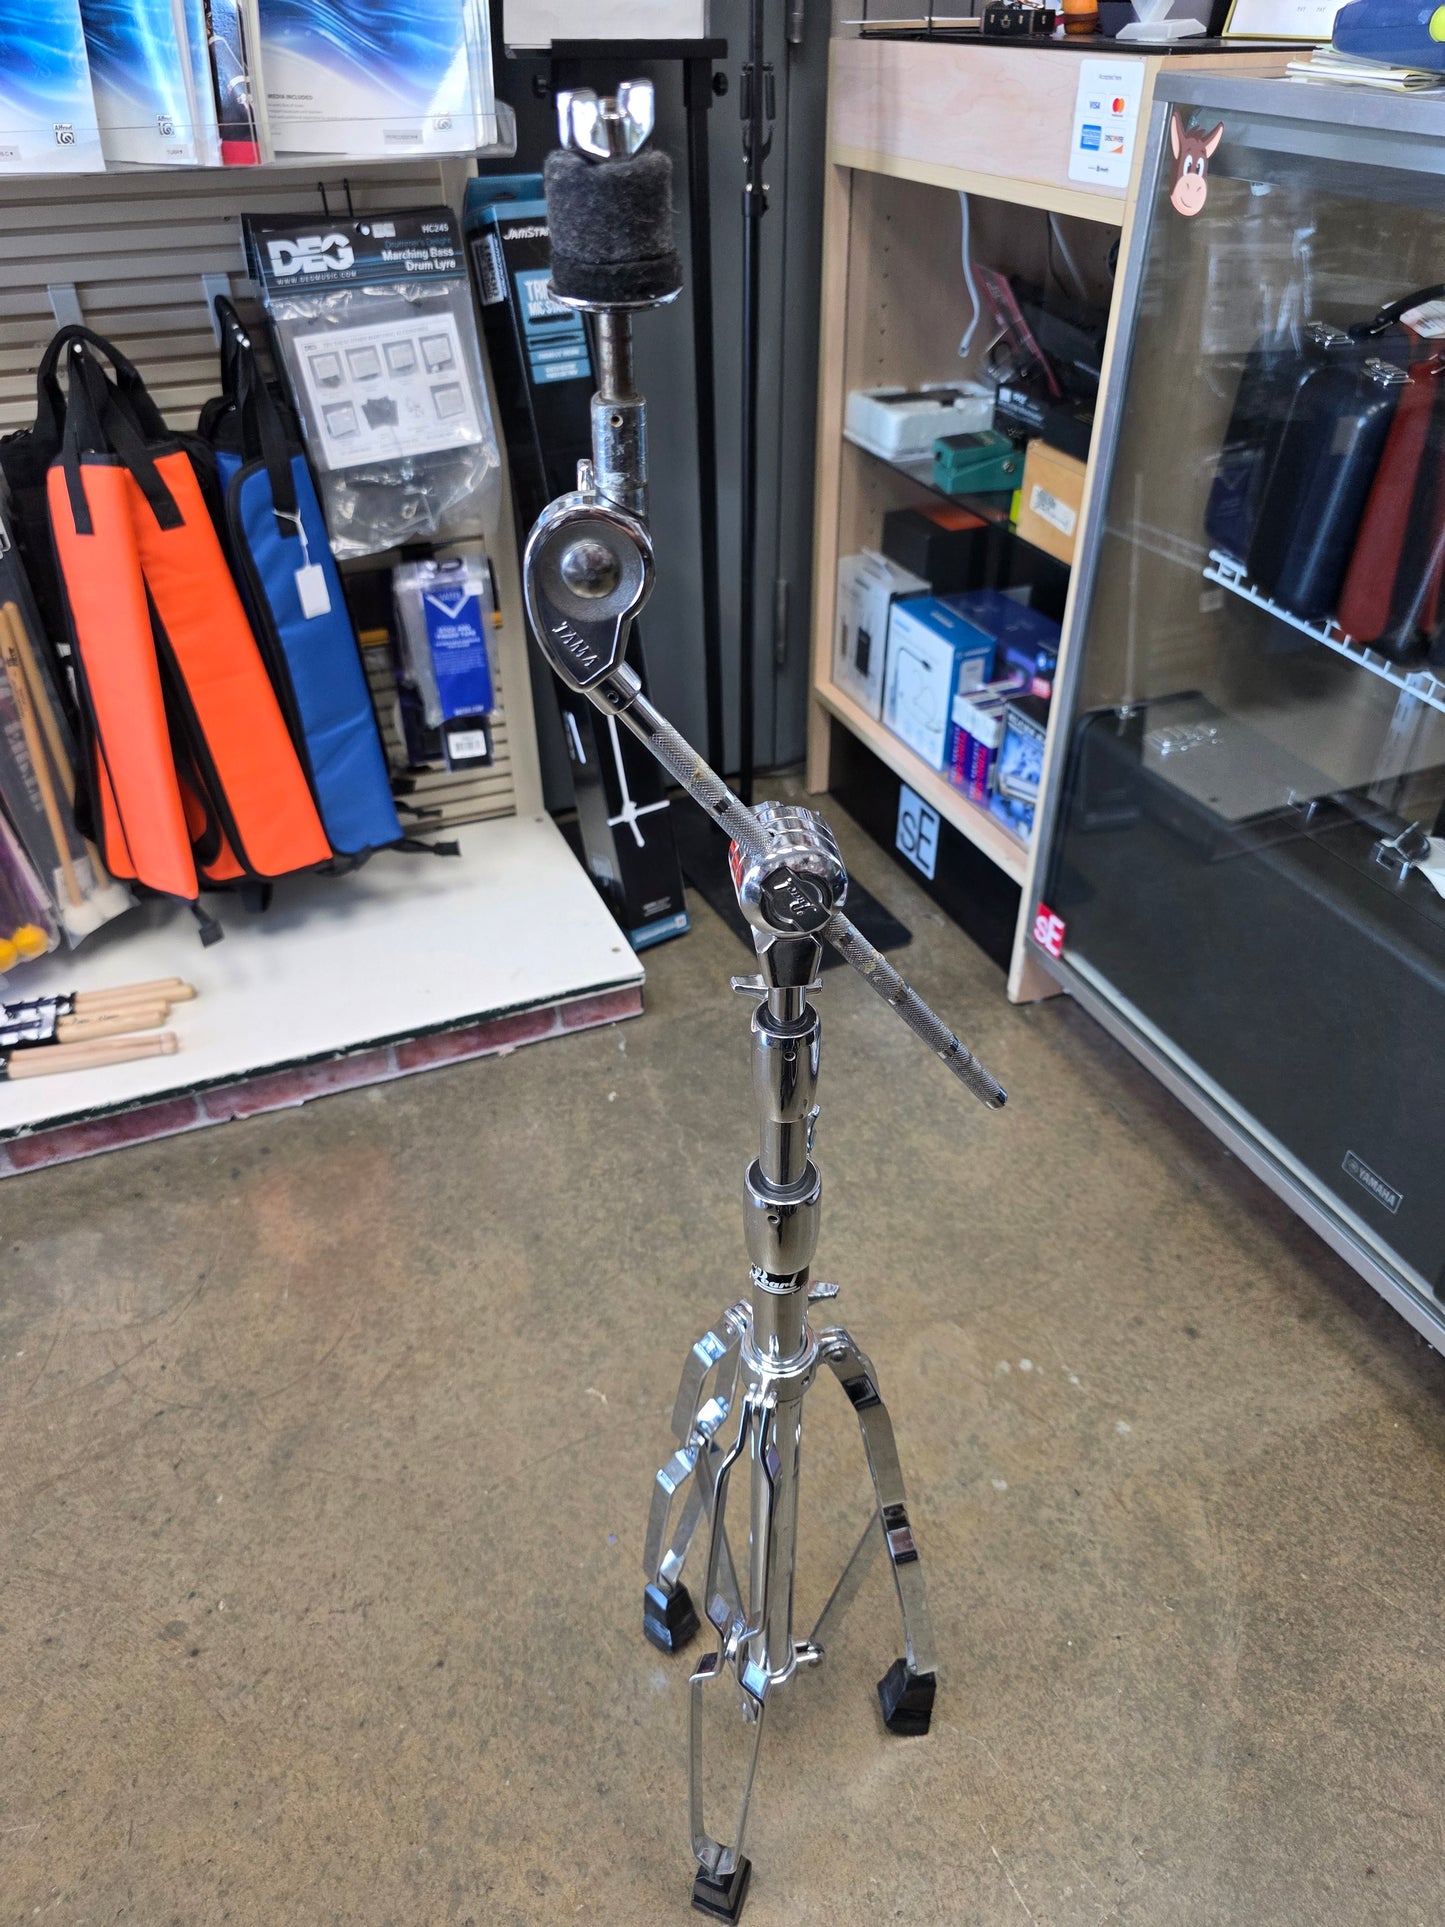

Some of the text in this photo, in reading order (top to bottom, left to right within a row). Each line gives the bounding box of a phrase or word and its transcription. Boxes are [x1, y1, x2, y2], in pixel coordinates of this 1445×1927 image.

[1089, 101, 1101, 109] VISA
[267, 235, 355, 277] DEG
[381, 246, 454, 262] Marching Bass
[405, 258, 457, 272] Drum Lyre
[551, 620, 601, 668] TAMA
[1358, 1167, 1396, 1207] YAMAHA
[749, 1262, 800, 1289] Pearl
